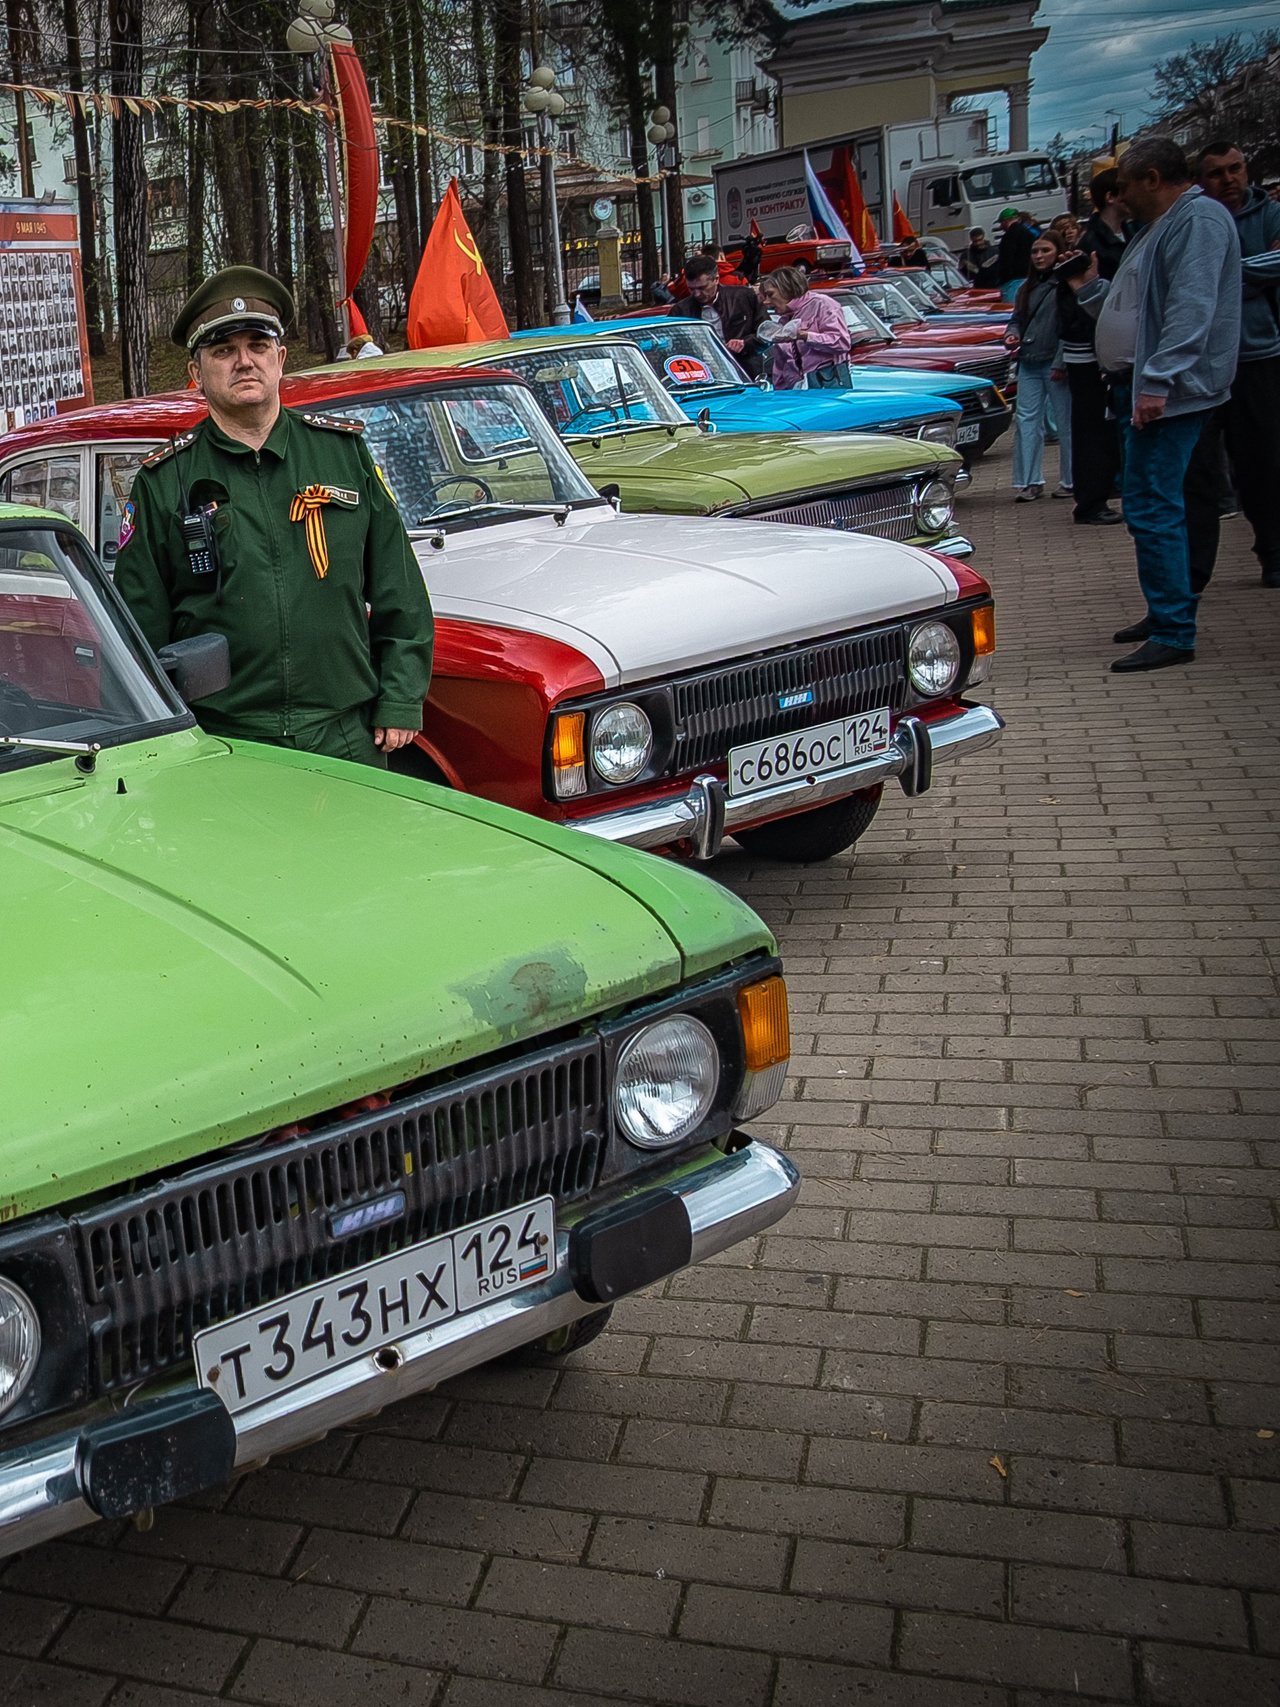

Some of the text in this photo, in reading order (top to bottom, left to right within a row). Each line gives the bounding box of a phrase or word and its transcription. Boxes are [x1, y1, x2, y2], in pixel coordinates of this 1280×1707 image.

[746, 207, 758, 218] ПО
[760, 197, 806, 215] КОНТРАКТУ
[15, 221, 47, 235] 9 МАЯ 1945
[676, 359, 696, 372] 51
[846, 714, 884, 747] 124
[854, 743, 873, 756] RUS
[459, 1212, 543, 1279] 124
[477, 1270, 519, 1297] RUS
